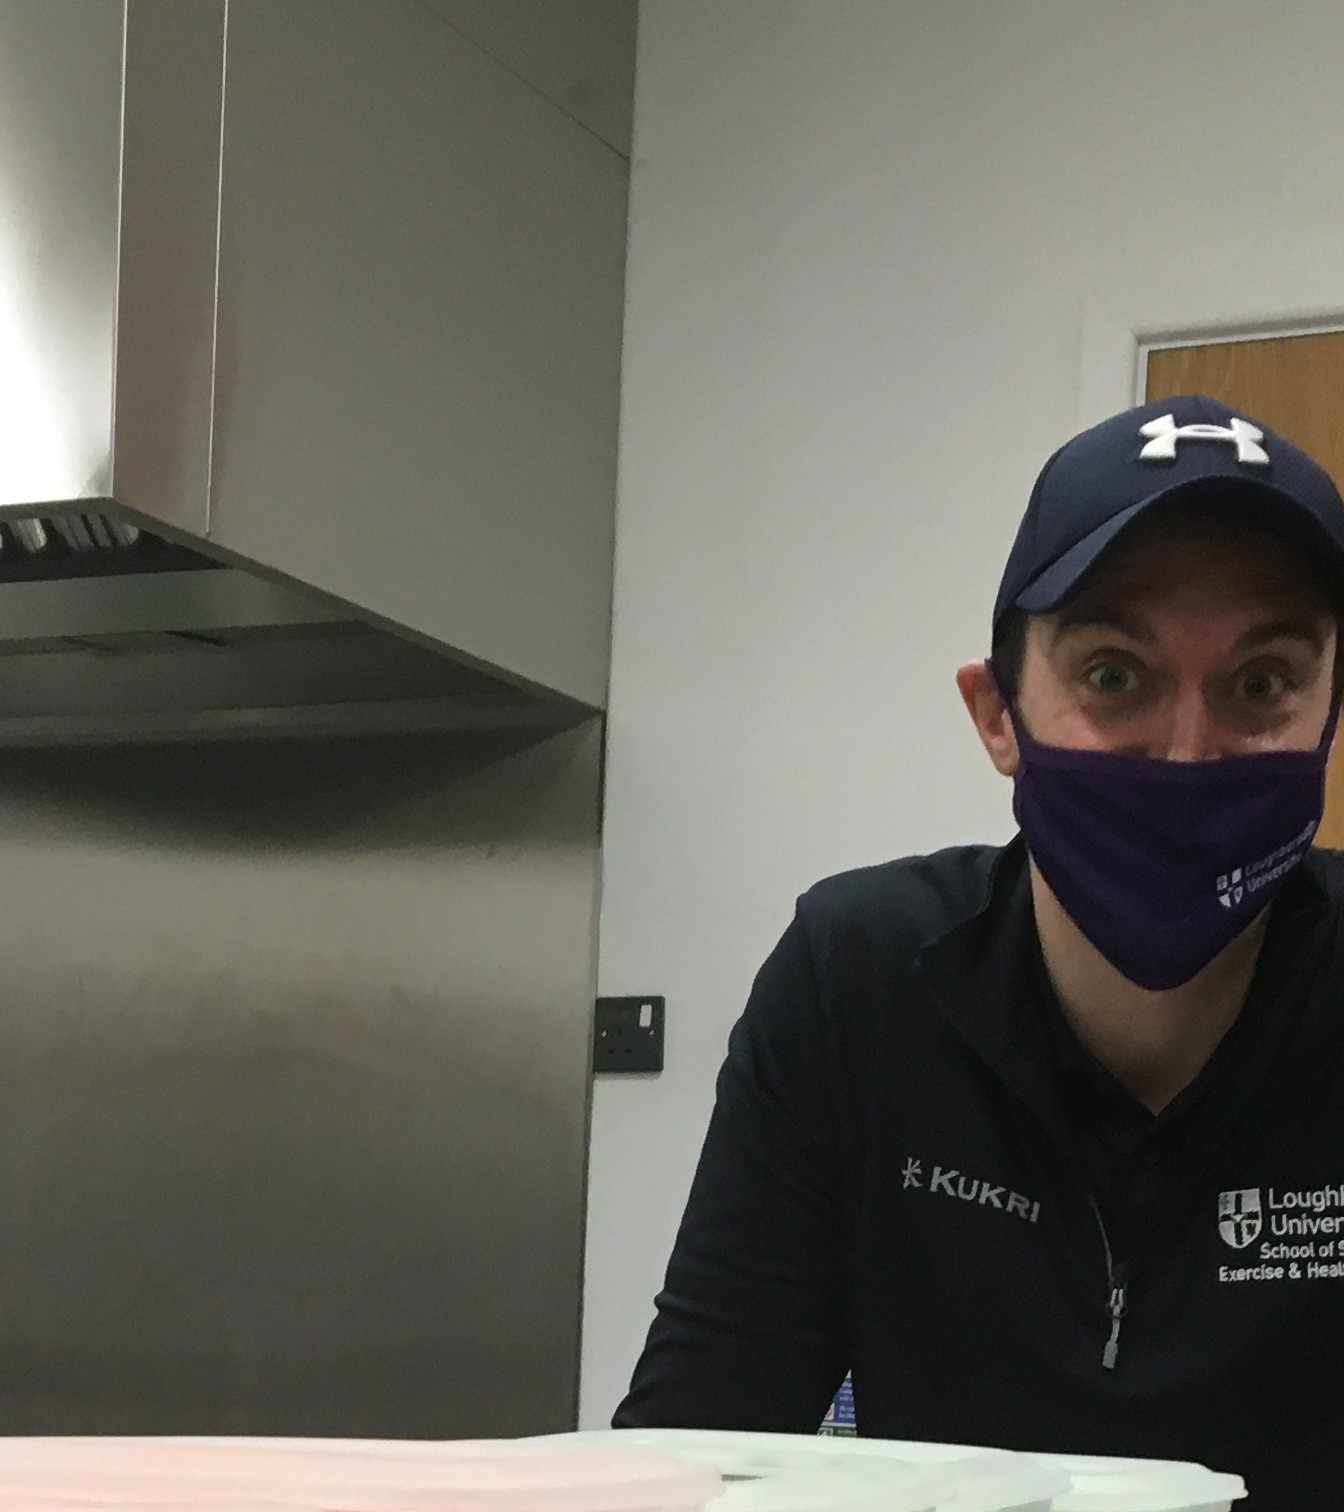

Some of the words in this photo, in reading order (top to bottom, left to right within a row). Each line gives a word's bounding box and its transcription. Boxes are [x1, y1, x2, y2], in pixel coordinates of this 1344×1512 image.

[929, 1165, 1041, 1223] KUKRI
[1259, 1241, 1315, 1259] School
[1318, 1241, 1335, 1257] of
[1218, 1263, 1285, 1282] Exercise
[1288, 1262, 1302, 1279] &
